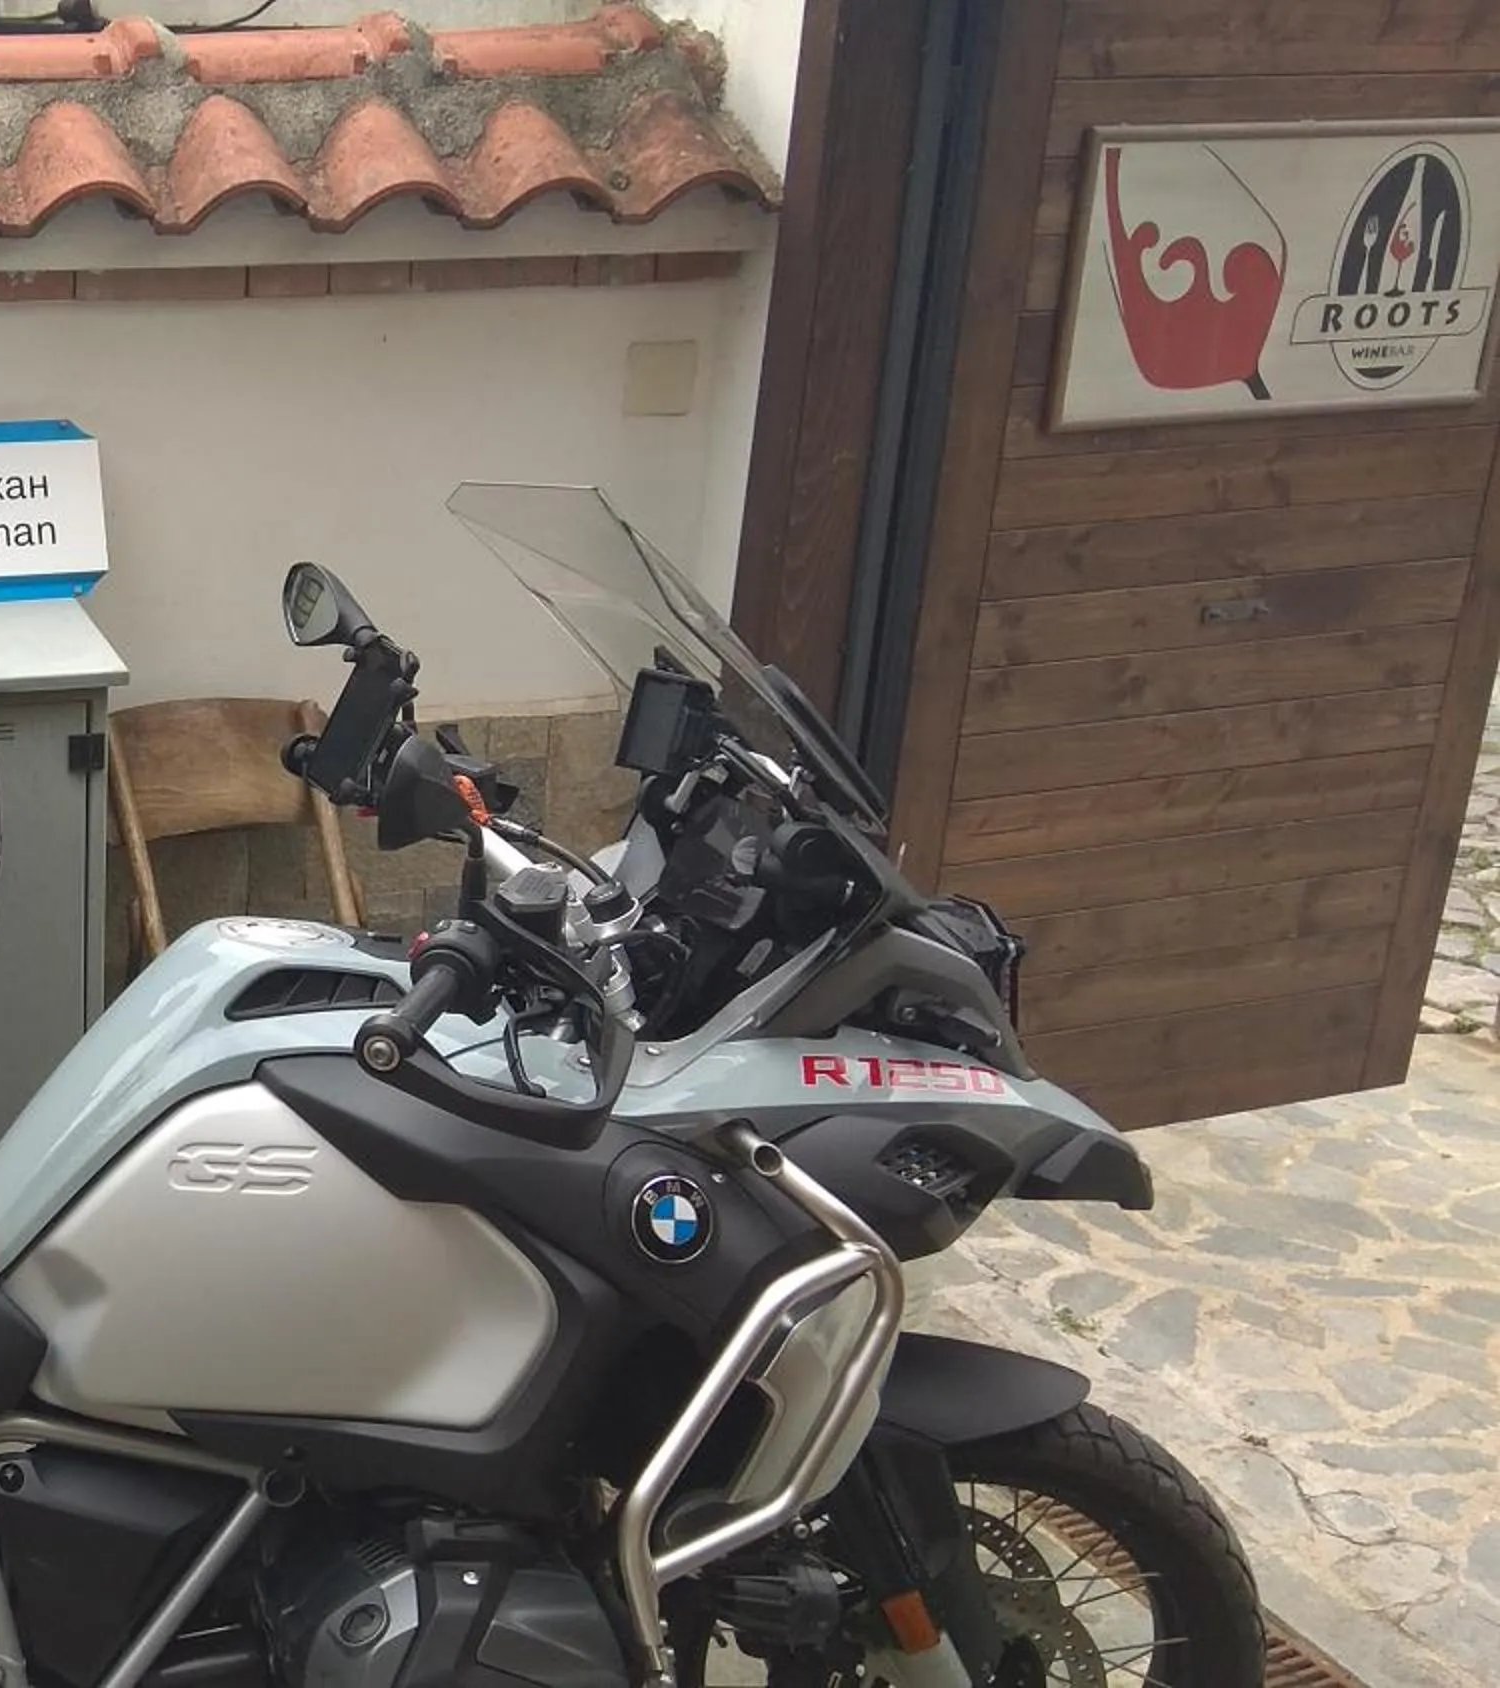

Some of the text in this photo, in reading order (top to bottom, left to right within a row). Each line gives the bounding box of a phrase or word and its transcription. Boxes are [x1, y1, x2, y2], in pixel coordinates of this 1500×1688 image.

[1320, 300, 1461, 333] ROOTS
[167, 1142, 319, 1195] GS
[643, 1181, 705, 1208] BMW
